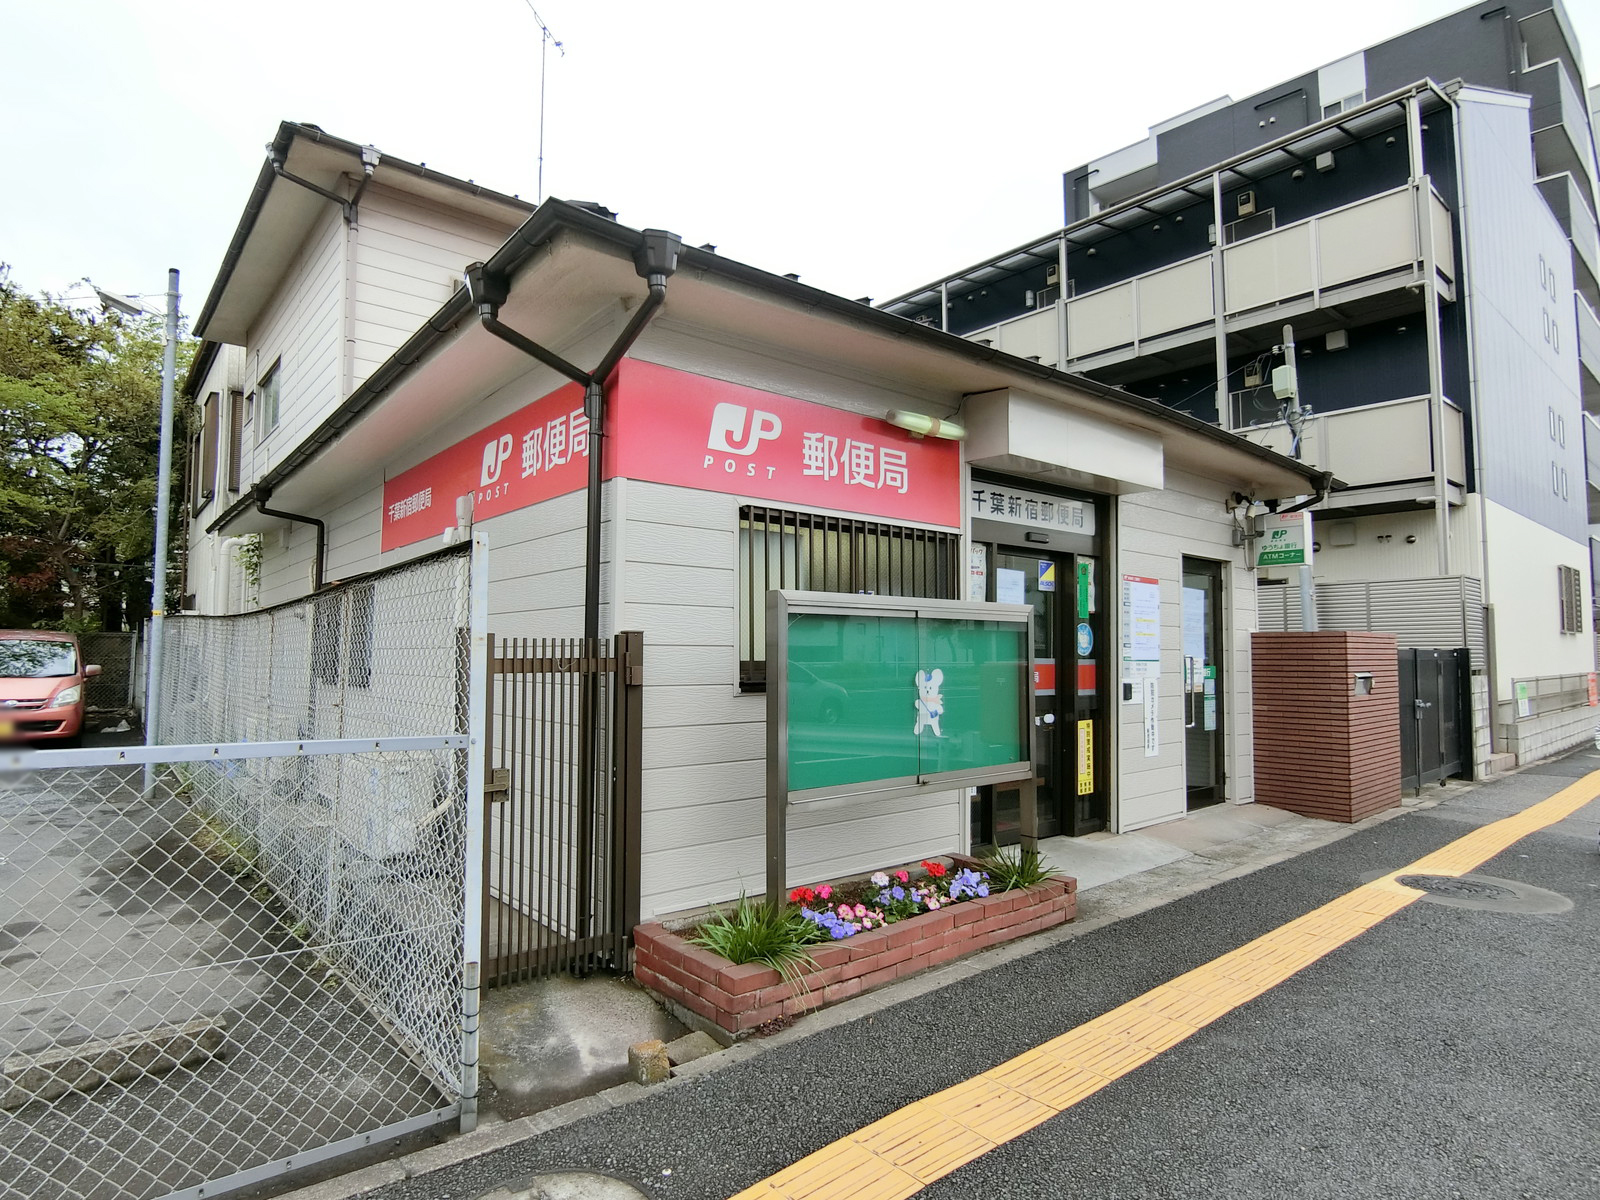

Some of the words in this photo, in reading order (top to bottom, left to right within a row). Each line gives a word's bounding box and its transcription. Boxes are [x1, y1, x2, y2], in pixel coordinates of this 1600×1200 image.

[521, 406, 590, 479] 郵便局
[703, 455, 776, 480] POST
[802, 431, 909, 494] 郵便局
[388, 487, 432, 523] 千葉新宿郵便局
[478, 482, 510, 505] POST
[972, 490, 1084, 528] 千葉新宿郵便局
[1263, 552, 1301, 560] ATMコーナー
